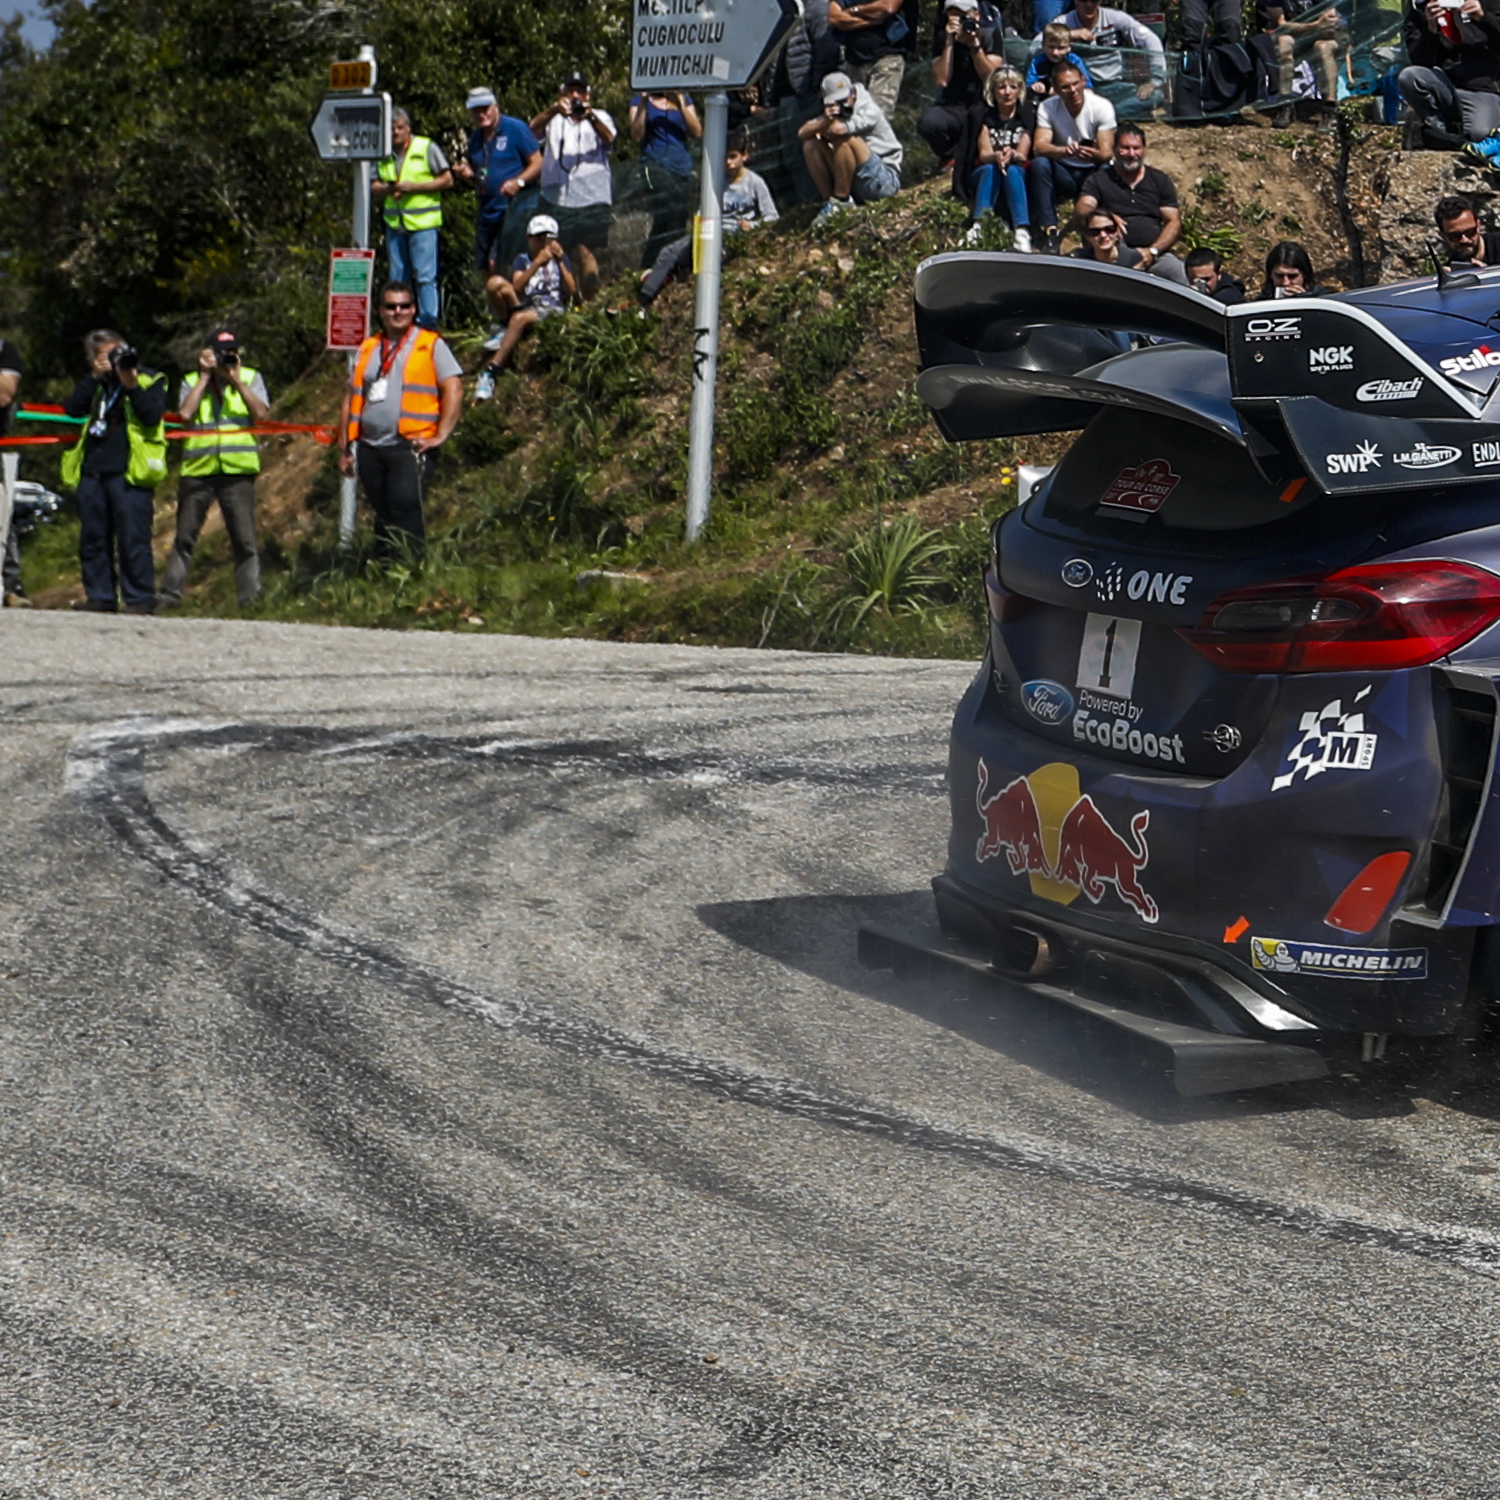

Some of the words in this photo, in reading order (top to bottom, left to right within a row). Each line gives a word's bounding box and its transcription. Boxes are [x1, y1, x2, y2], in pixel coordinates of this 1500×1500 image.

[637, 22, 725, 48] CUGNOCULU
[1309, 345, 1354, 366] NGK
[1331, 363, 1354, 371] PLUGS
[1356, 377, 1425, 402] Eibach
[1326, 453, 1372, 475] SWP
[1127, 569, 1194, 605] ONE
[1097, 618, 1119, 689] 1
[1078, 689, 1128, 716] Powered
[1128, 700, 1144, 724] by
[1072, 709, 1187, 764] EcoBoost
[1326, 735, 1361, 764] M
[1361, 736, 1374, 767] SPORT
[1300, 950, 1424, 970] MICHELIN
